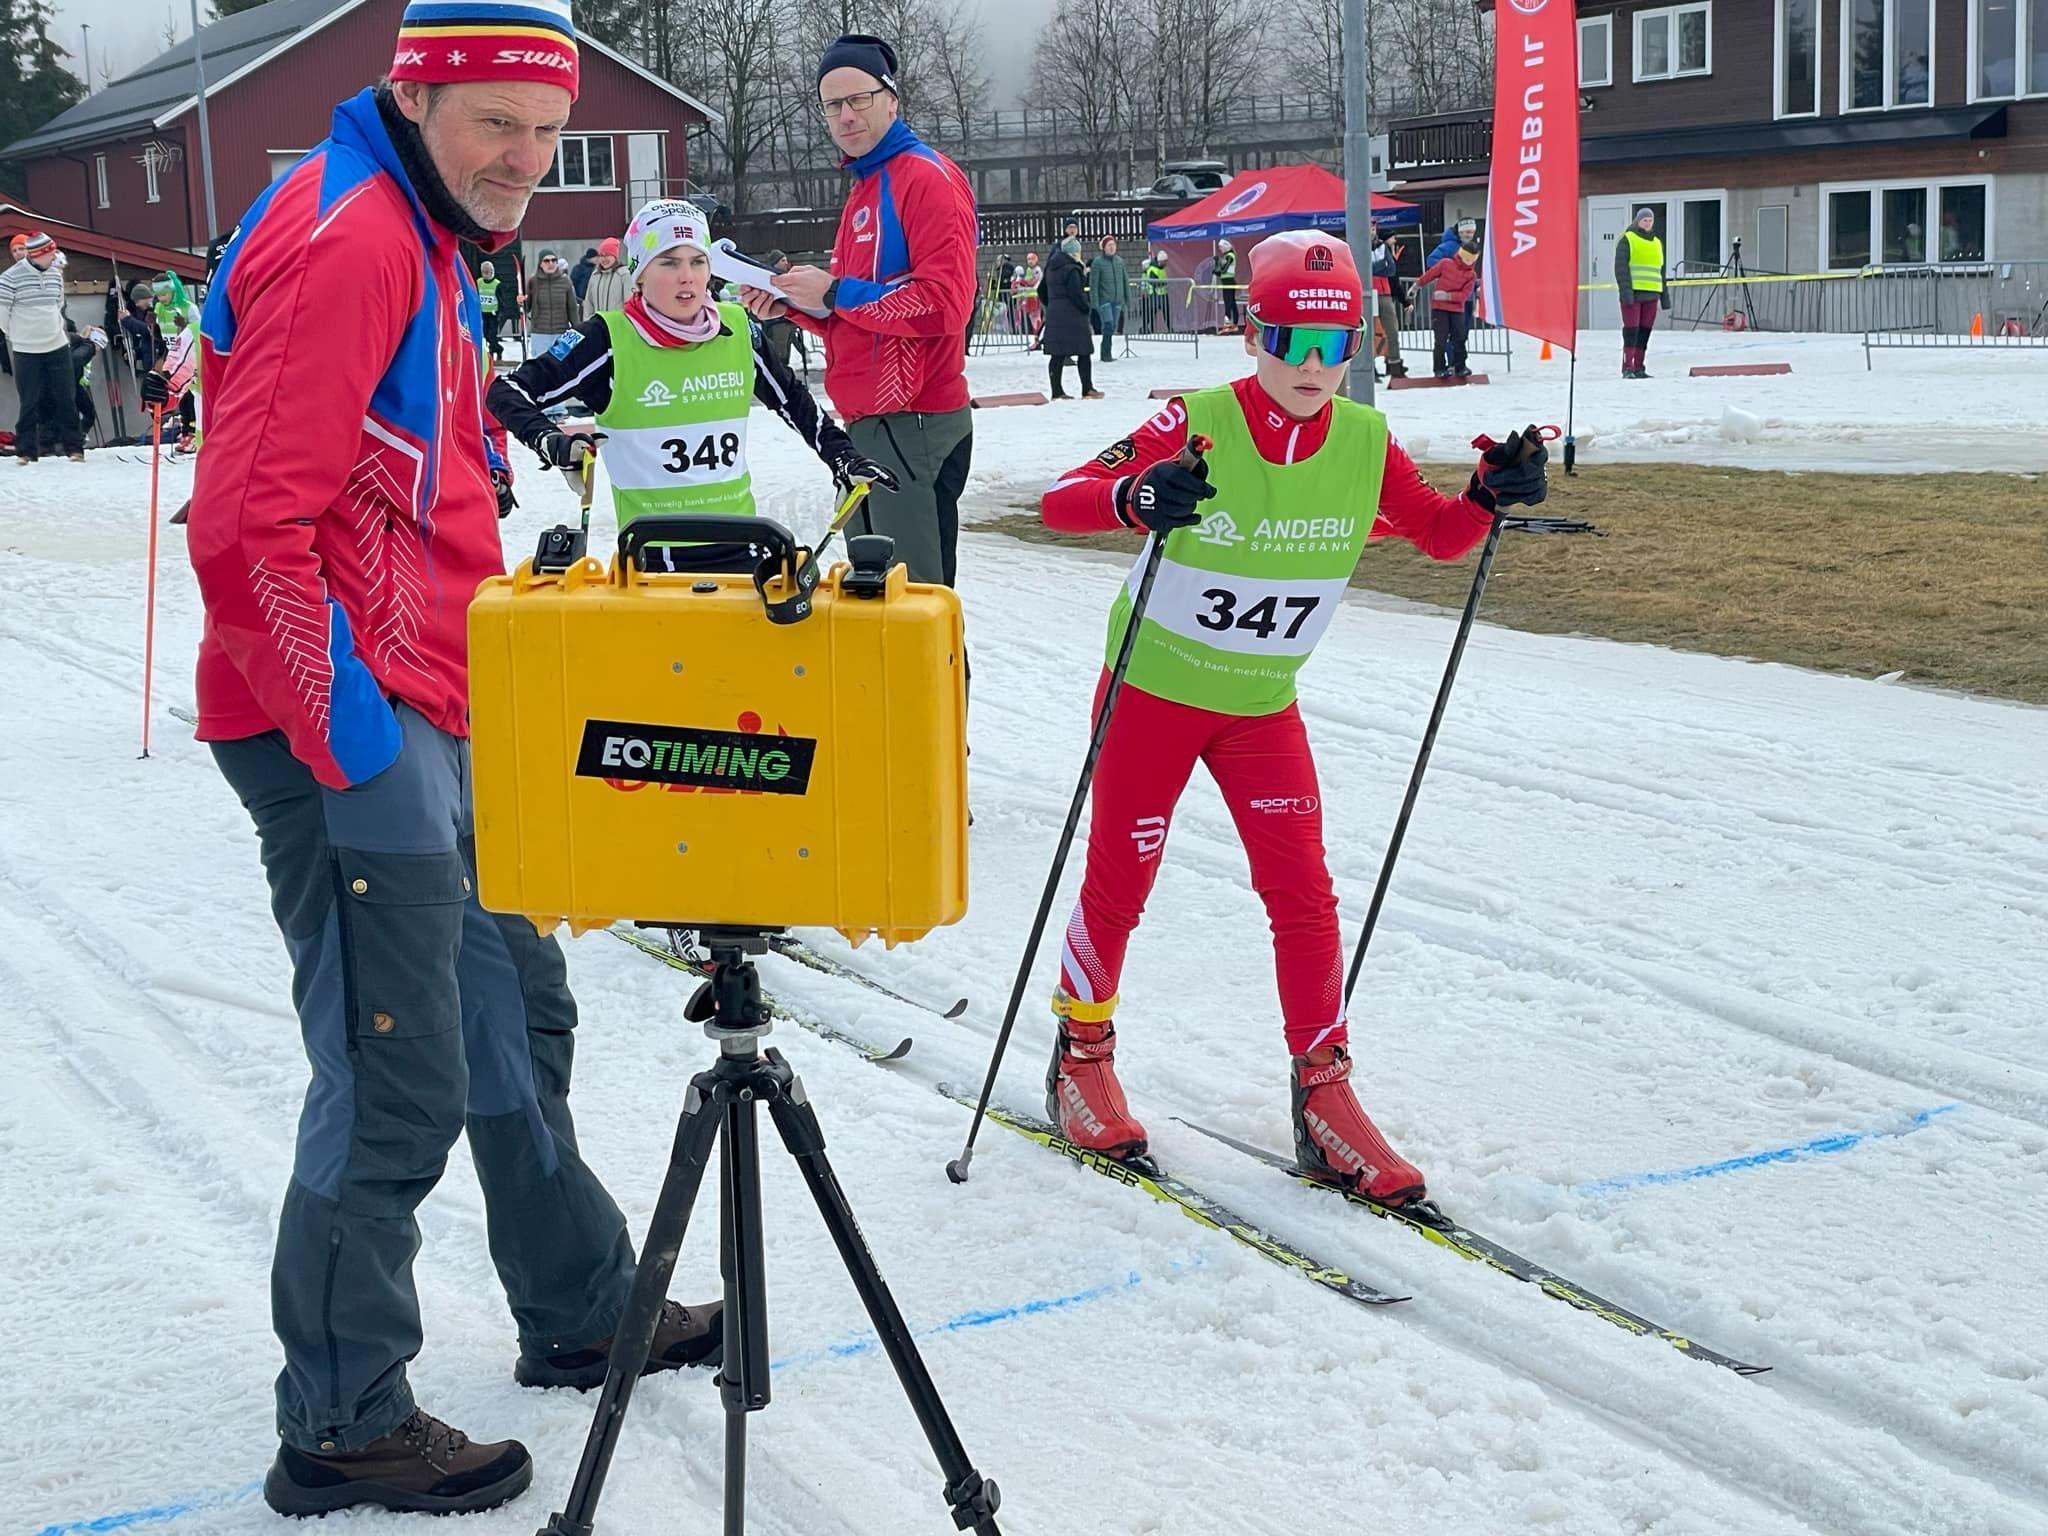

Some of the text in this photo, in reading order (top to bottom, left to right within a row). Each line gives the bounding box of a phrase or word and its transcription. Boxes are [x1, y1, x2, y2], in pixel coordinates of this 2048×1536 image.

[393, 48, 427, 66] wix
[1288, 289, 1352, 299] OSEBERG
[1296, 300, 1348, 311] SKILAG
[681, 371, 745, 393] ANDEBU
[660, 432, 740, 474] 348
[1254, 517, 1355, 540] ANDEBU
[1250, 541, 1351, 552] SPAREBANK
[1195, 588, 1321, 639] 347
[1169, 643, 1201, 667] trivelig
[1204, 661, 1230, 673] bank
[1233, 667, 1257, 677] med
[1250, 799, 1300, 813] sport
[1048, 1138, 1140, 1187] FISCHER
